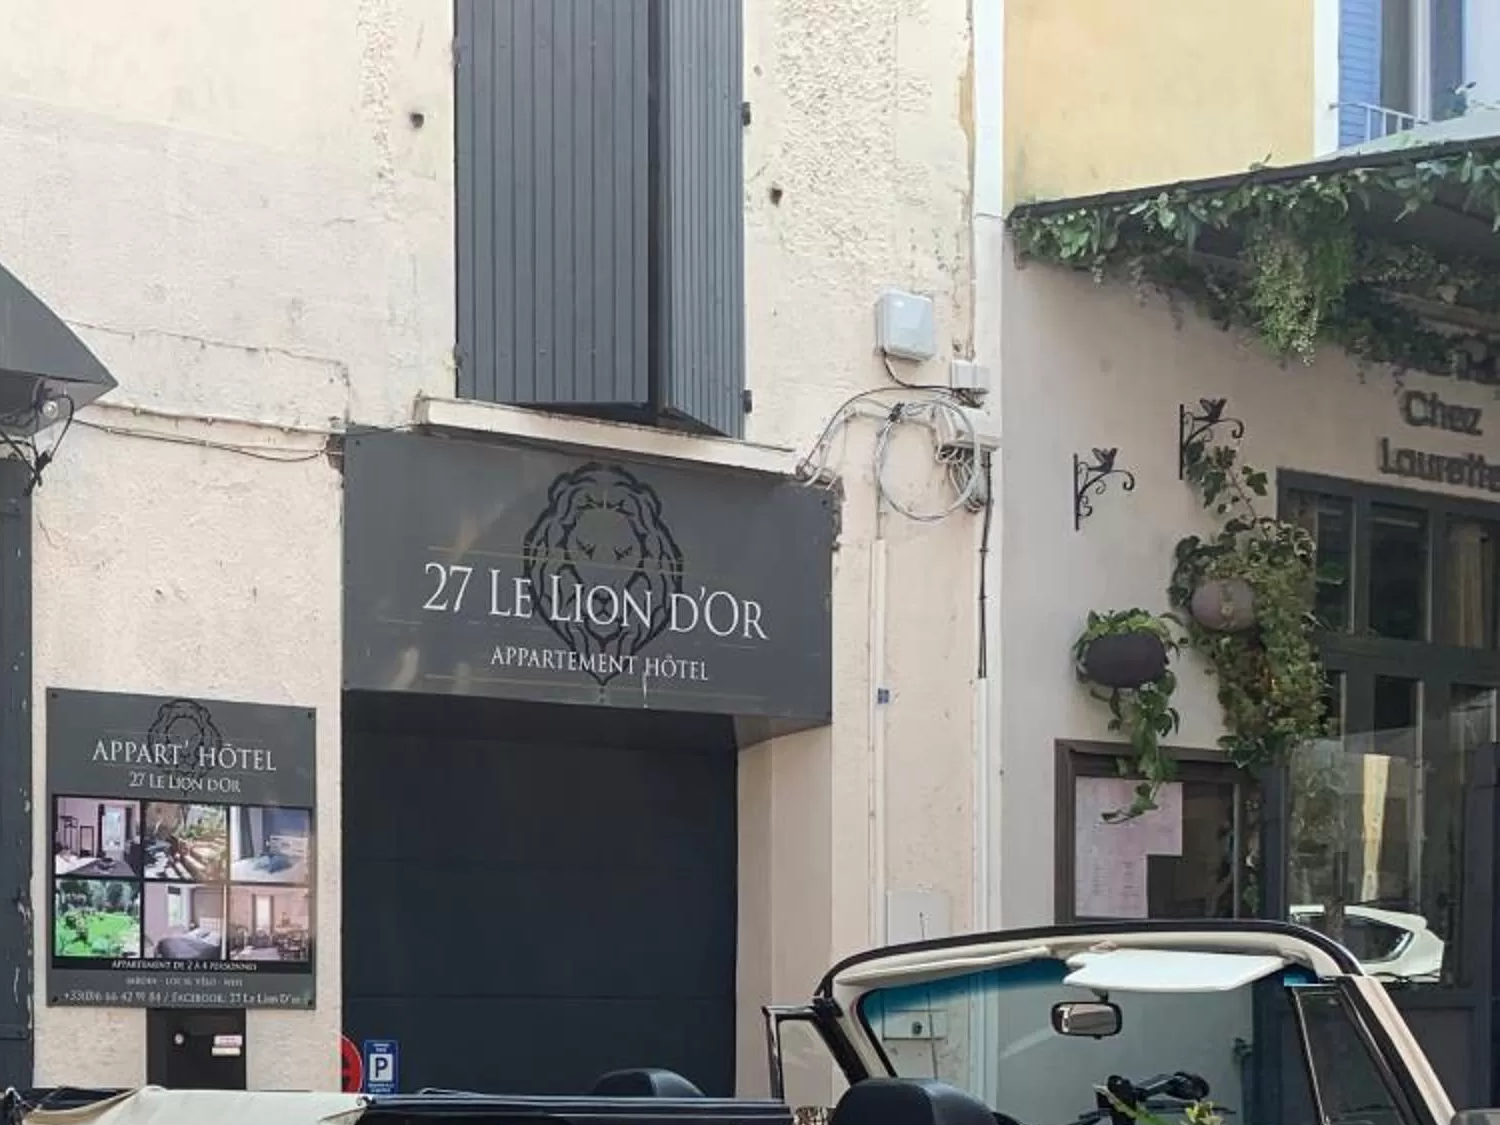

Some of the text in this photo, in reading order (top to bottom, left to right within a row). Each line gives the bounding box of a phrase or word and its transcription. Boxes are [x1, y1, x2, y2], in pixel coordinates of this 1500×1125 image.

[1402, 389, 1484, 436] Chez
[423, 563, 769, 641] 27 LE LION D'OR
[491, 645, 709, 681] APPARTEMENT HÔTEL
[92, 739, 277, 771] APPART' HÔTEL
[129, 771, 146, 787] 27
[150, 774, 164, 789] LE
[169, 775, 203, 792] LION
[375, 1057, 389, 1079] P
